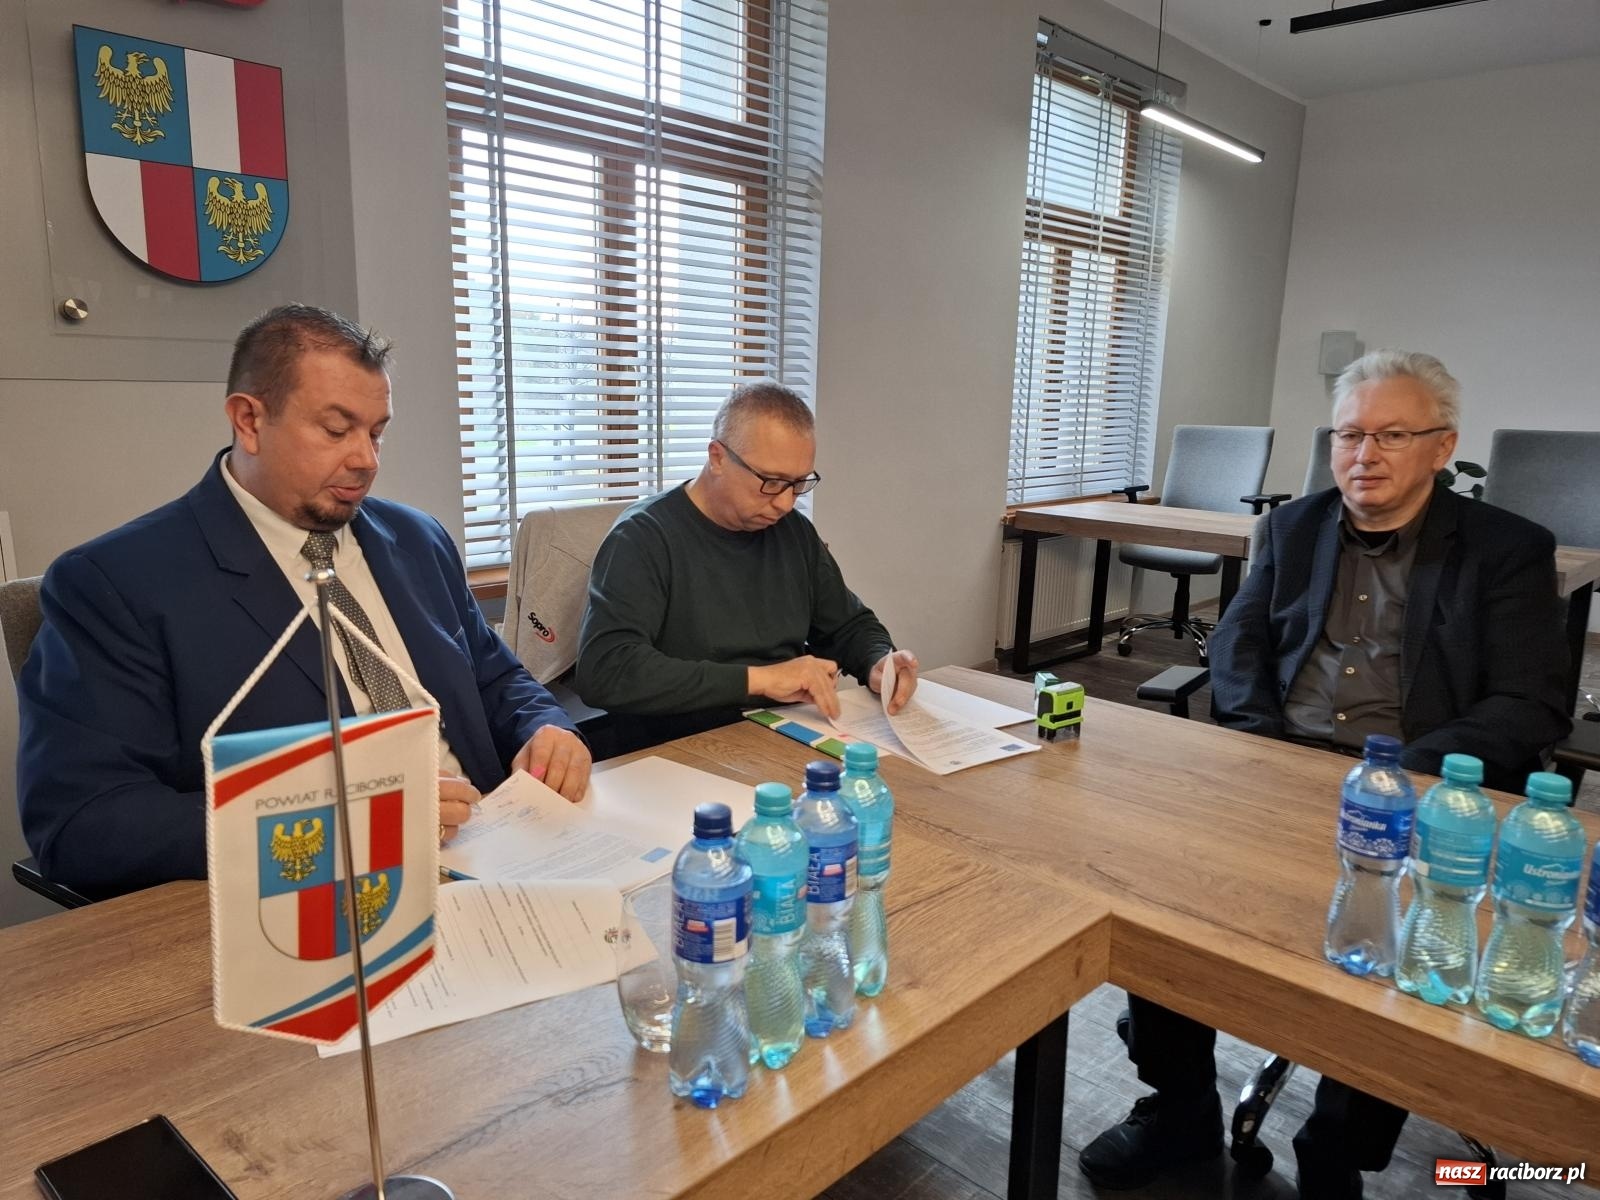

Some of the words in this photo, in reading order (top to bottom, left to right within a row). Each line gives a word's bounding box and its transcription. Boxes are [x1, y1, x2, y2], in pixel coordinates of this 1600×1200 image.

[527, 611, 549, 637] Sopro
[255, 790, 319, 811] POWIAT
[324, 773, 405, 800] RCIBORSKI
